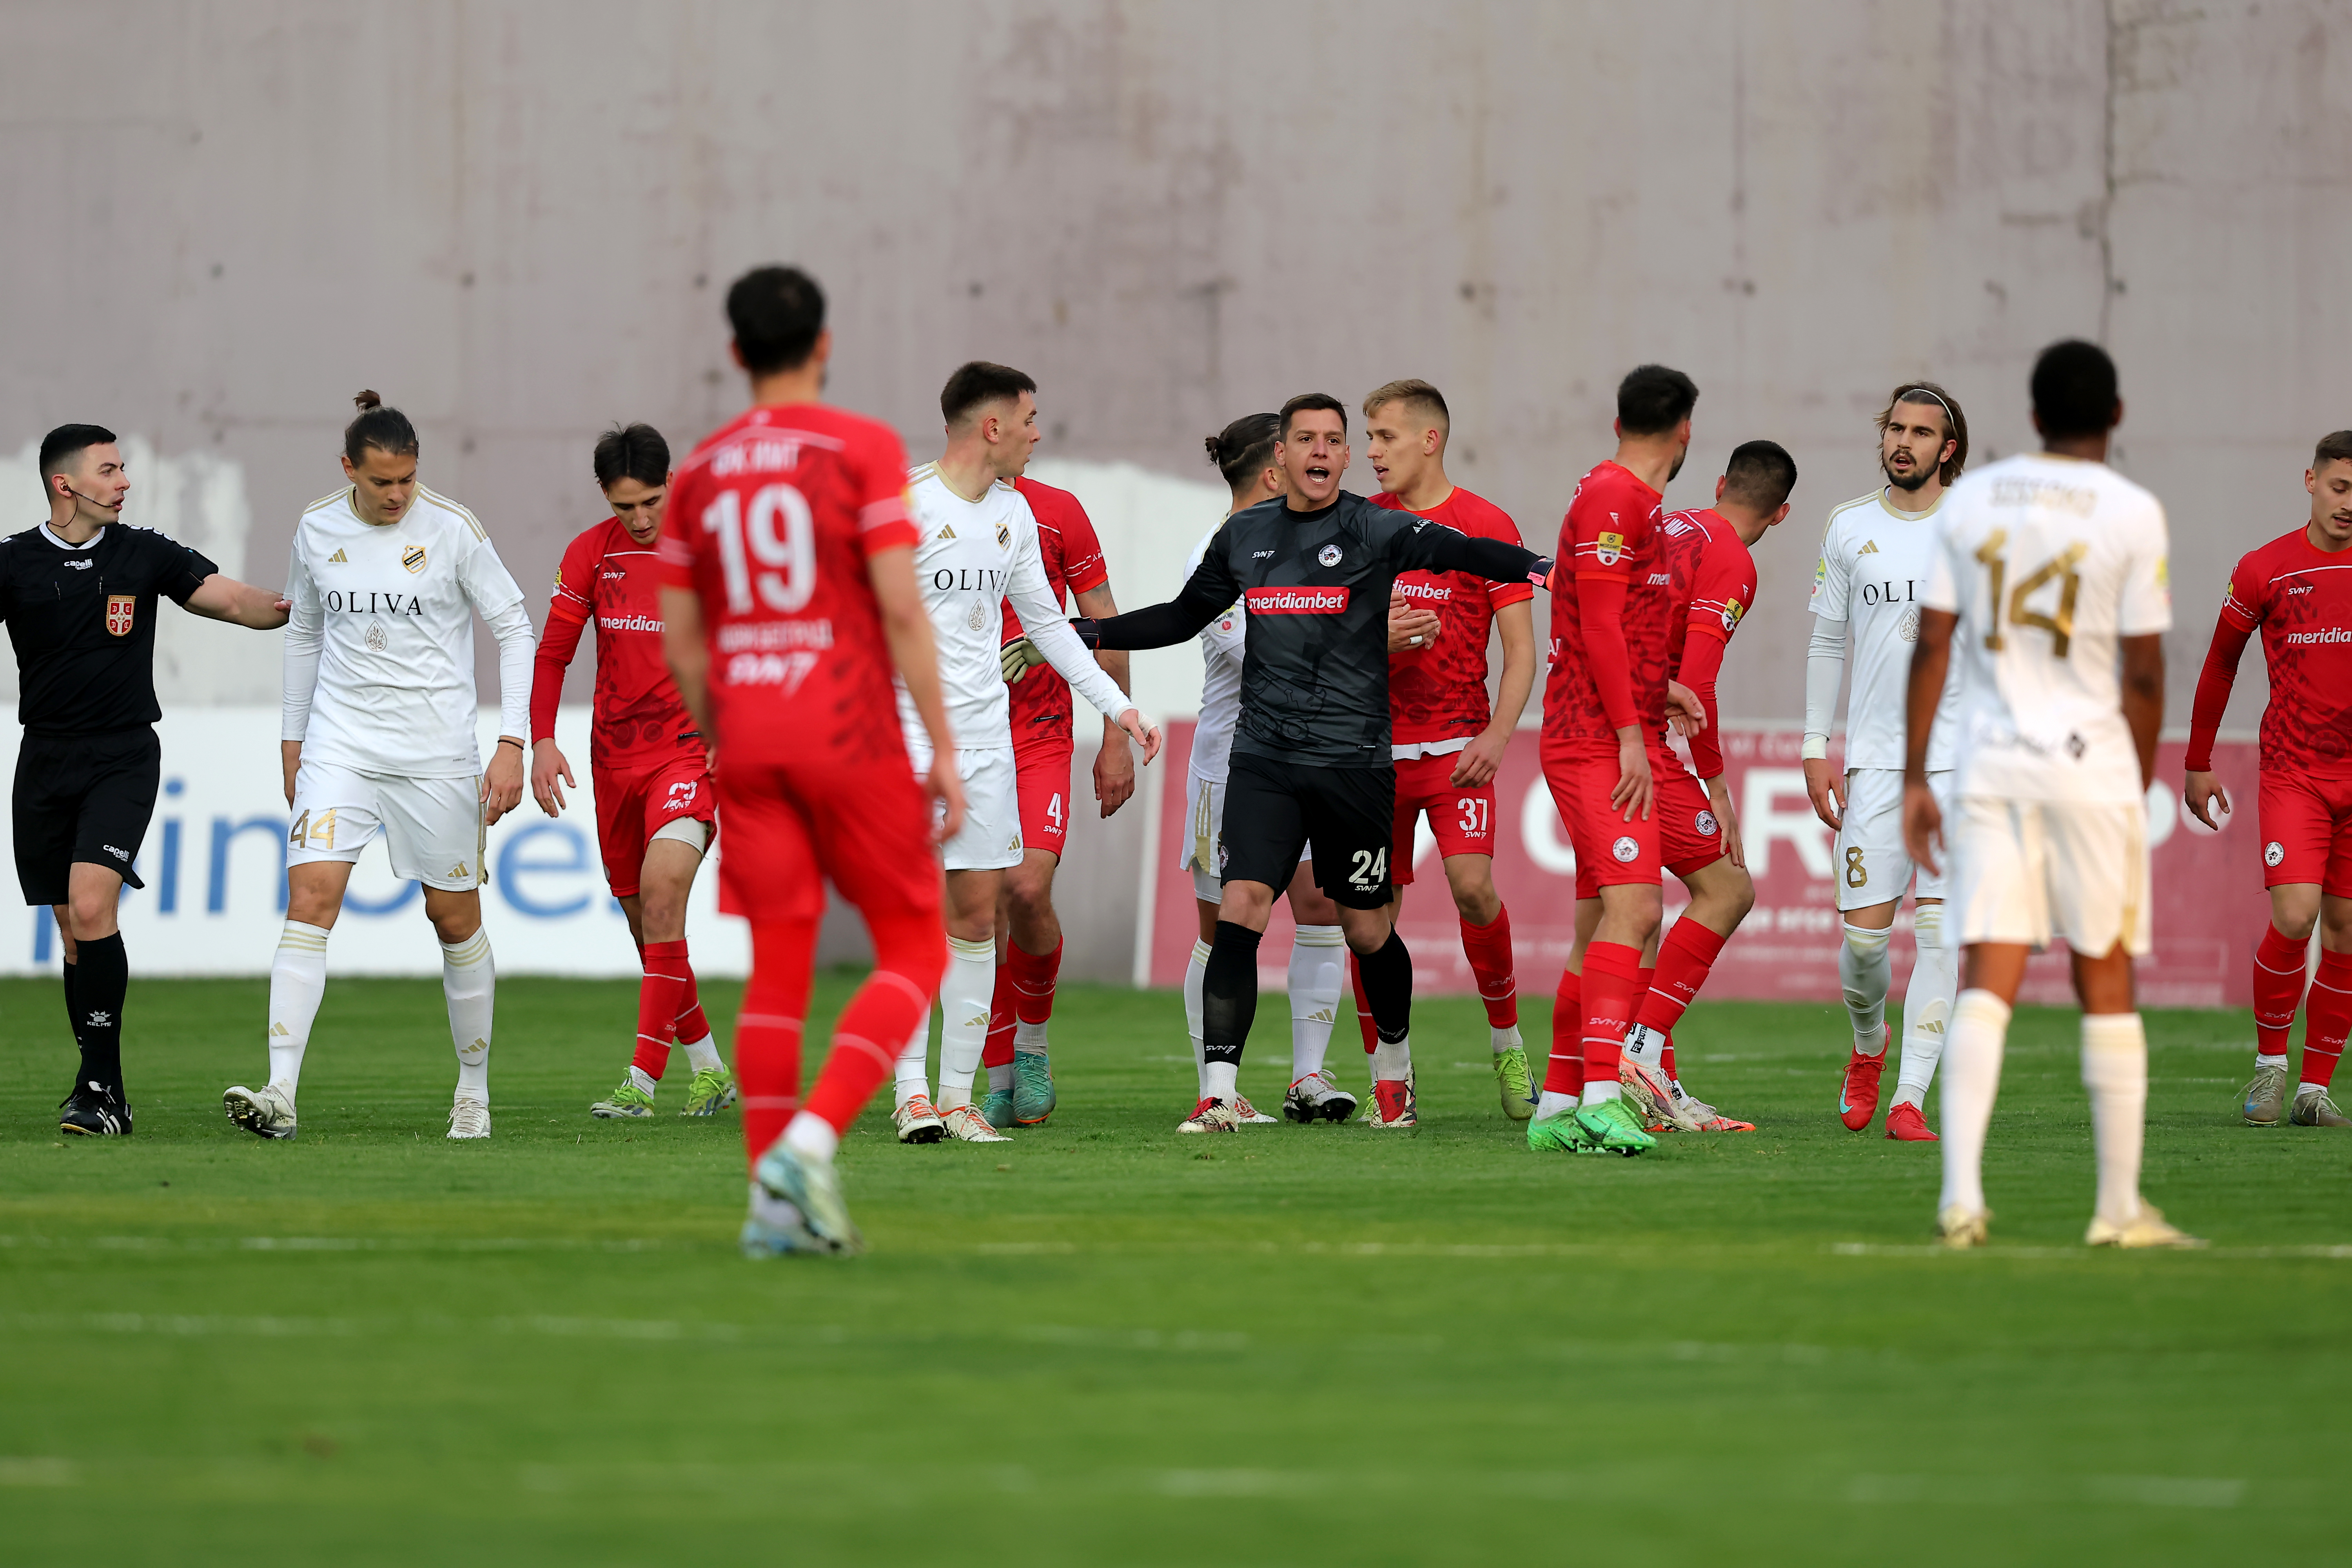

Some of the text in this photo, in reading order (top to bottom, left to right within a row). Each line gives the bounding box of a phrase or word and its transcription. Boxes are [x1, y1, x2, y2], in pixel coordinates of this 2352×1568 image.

[703, 483, 817, 615] 19
[1252, 550, 1275, 559] SVN7
[64, 558, 93, 569] capelli
[602, 572, 626, 582] SVN7
[1864, 580, 1915, 606] OLI
[1975, 528, 2089, 658] 14
[2288, 586, 2314, 596] SVN7
[328, 590, 423, 615] OLIVA
[1249, 592, 1344, 610] meridianbet
[601, 614, 665, 632] meridian
[2287, 627, 2352, 644] meridia
[1047, 792, 1063, 828] 4
[1457, 797, 1488, 831] 37
[290, 809, 337, 850] 44
[1043, 825, 1063, 838] SVN7
[1465, 831, 1487, 840] SVN7
[103, 844, 130, 860] capelli
[115, 854, 128, 862] SPORT
[1348, 846, 1387, 884] 24
[1846, 846, 1867, 888] 8
[1354, 884, 1379, 894] SVN7
[1673, 981, 1697, 996] SVN
[1632, 1042, 1642, 1053] FS
[1638, 1025, 1648, 1043] FOOTB
[1206, 1045, 1236, 1054] SVN7
